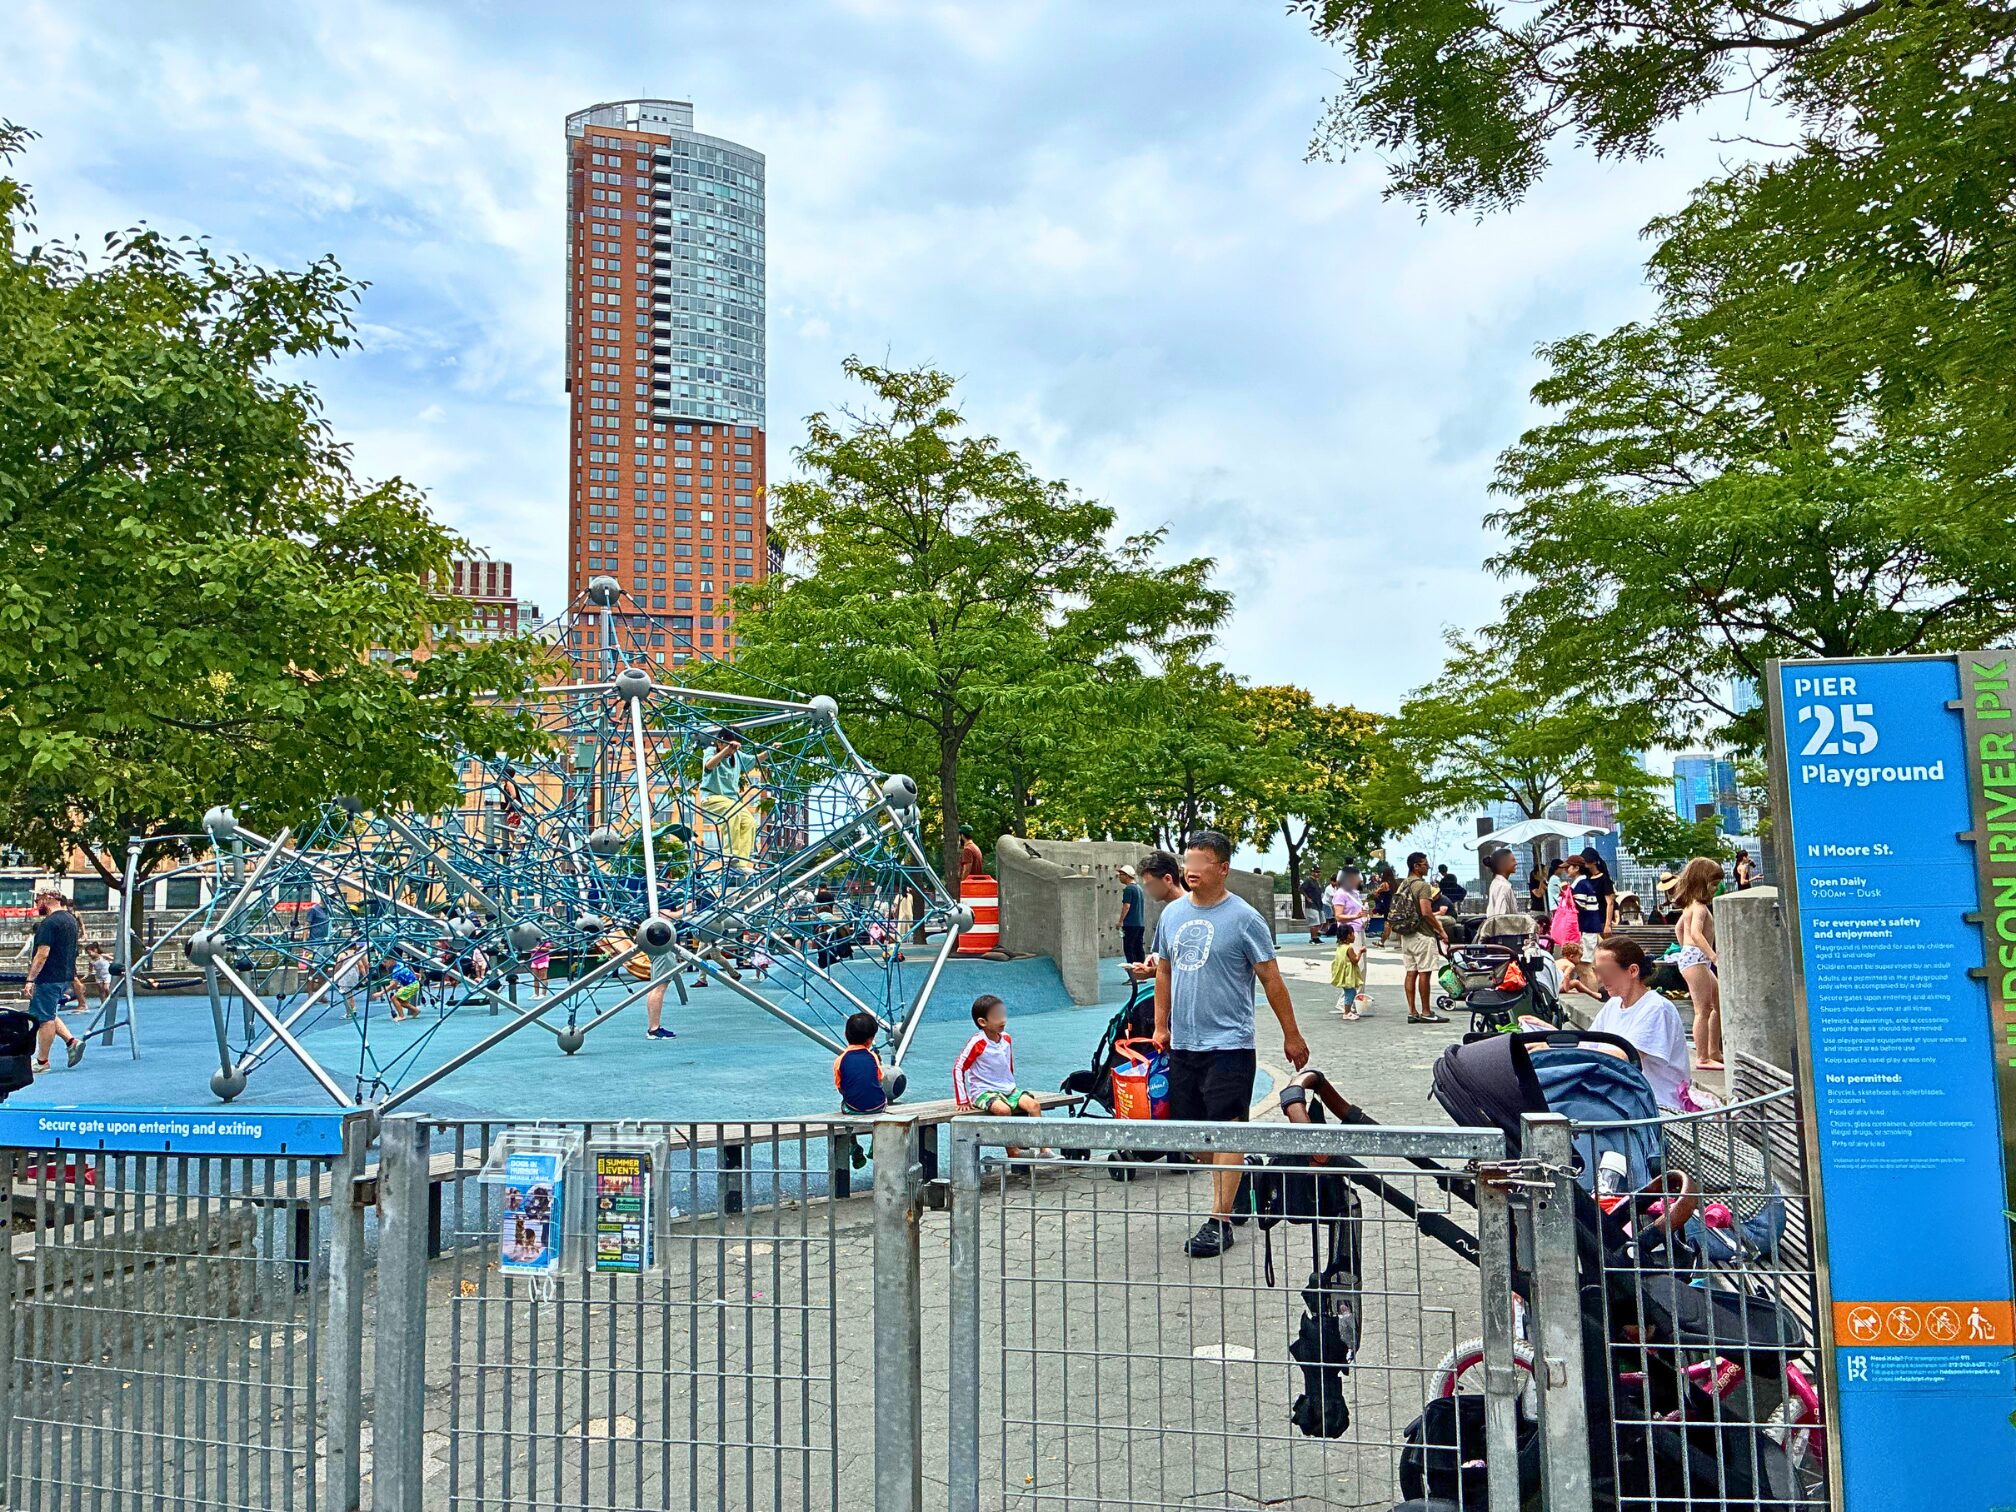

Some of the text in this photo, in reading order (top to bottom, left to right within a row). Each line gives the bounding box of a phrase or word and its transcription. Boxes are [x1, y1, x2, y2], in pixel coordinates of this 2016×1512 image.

[1794, 677, 1857, 697] PIER
[1971, 659, 2012, 720] PK
[1798, 704, 1879, 756] 25
[1802, 760, 1944, 787] Playground
[1980, 732, 2016, 862] RIVER
[1808, 843, 1894, 857] N Moore St.
[1810, 877, 1867, 888] Open Daily
[1857, 888, 1882, 898] Dusk
[1812, 917, 1921, 929] For everyone's safety
[1814, 929, 1893, 940] and enjoyment:
[1815, 944, 1853, 952] Playground
[1826, 1074, 1902, 1084] Not permitted:
[38, 1118, 263, 1139] Secure gate upon entering and exiting
[606, 1158, 640, 1167] SUMMER
[606, 1167, 640, 1175] EVENTS
